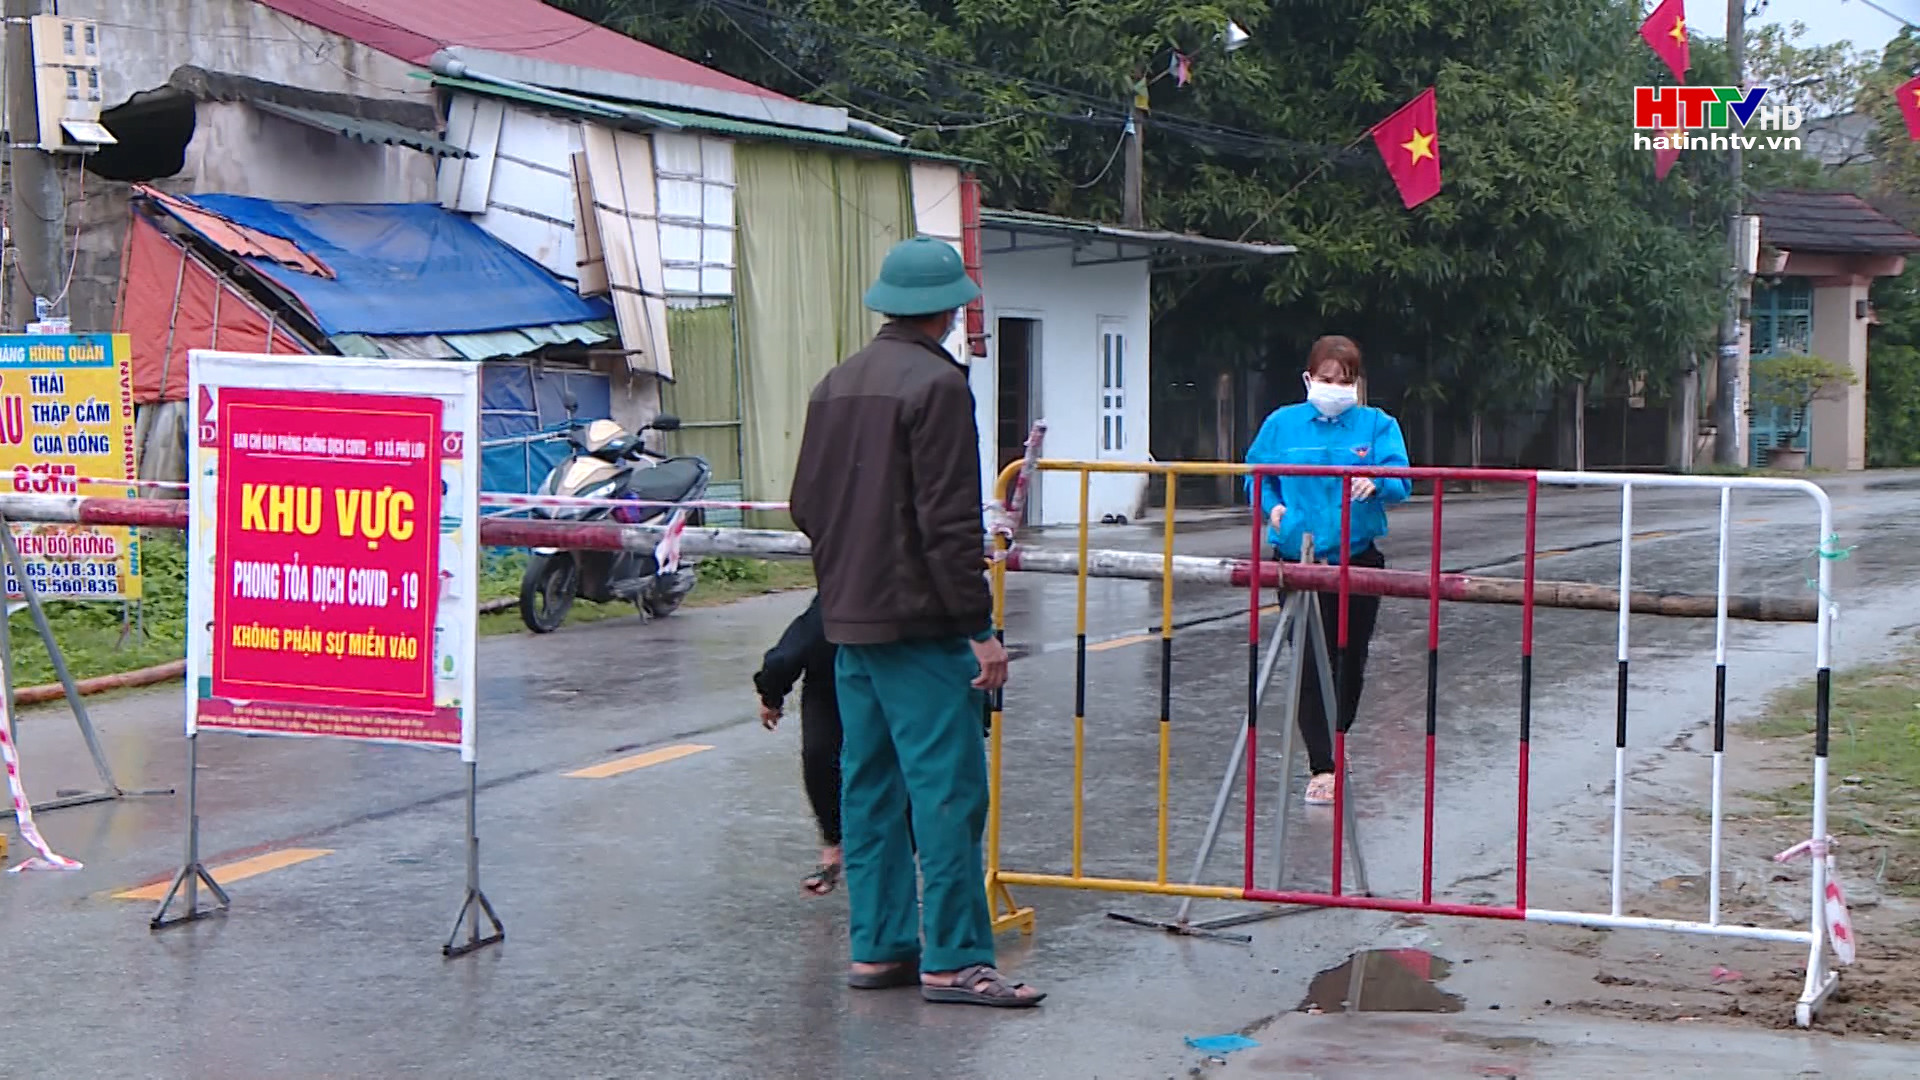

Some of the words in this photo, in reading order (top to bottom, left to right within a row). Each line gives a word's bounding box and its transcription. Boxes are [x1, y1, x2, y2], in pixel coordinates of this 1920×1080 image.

[32, 401, 71, 426] THẬP
[34, 435, 63, 453] CUA
[241, 483, 322, 535] KHU
[335, 485, 415, 550] VỰC
[233, 560, 280, 600] PHONG
[283, 551, 309, 602] TỎA
[312, 564, 345, 612] DỊCH
[348, 567, 388, 608] COVID
[401, 571, 419, 610] 19
[232, 621, 280, 650] KHÔNG
[283, 624, 322, 658] PHẬN
[326, 630, 348, 660] SỰ
[348, 625, 386, 658] MIỄN
[389, 631, 418, 660] VÀO
